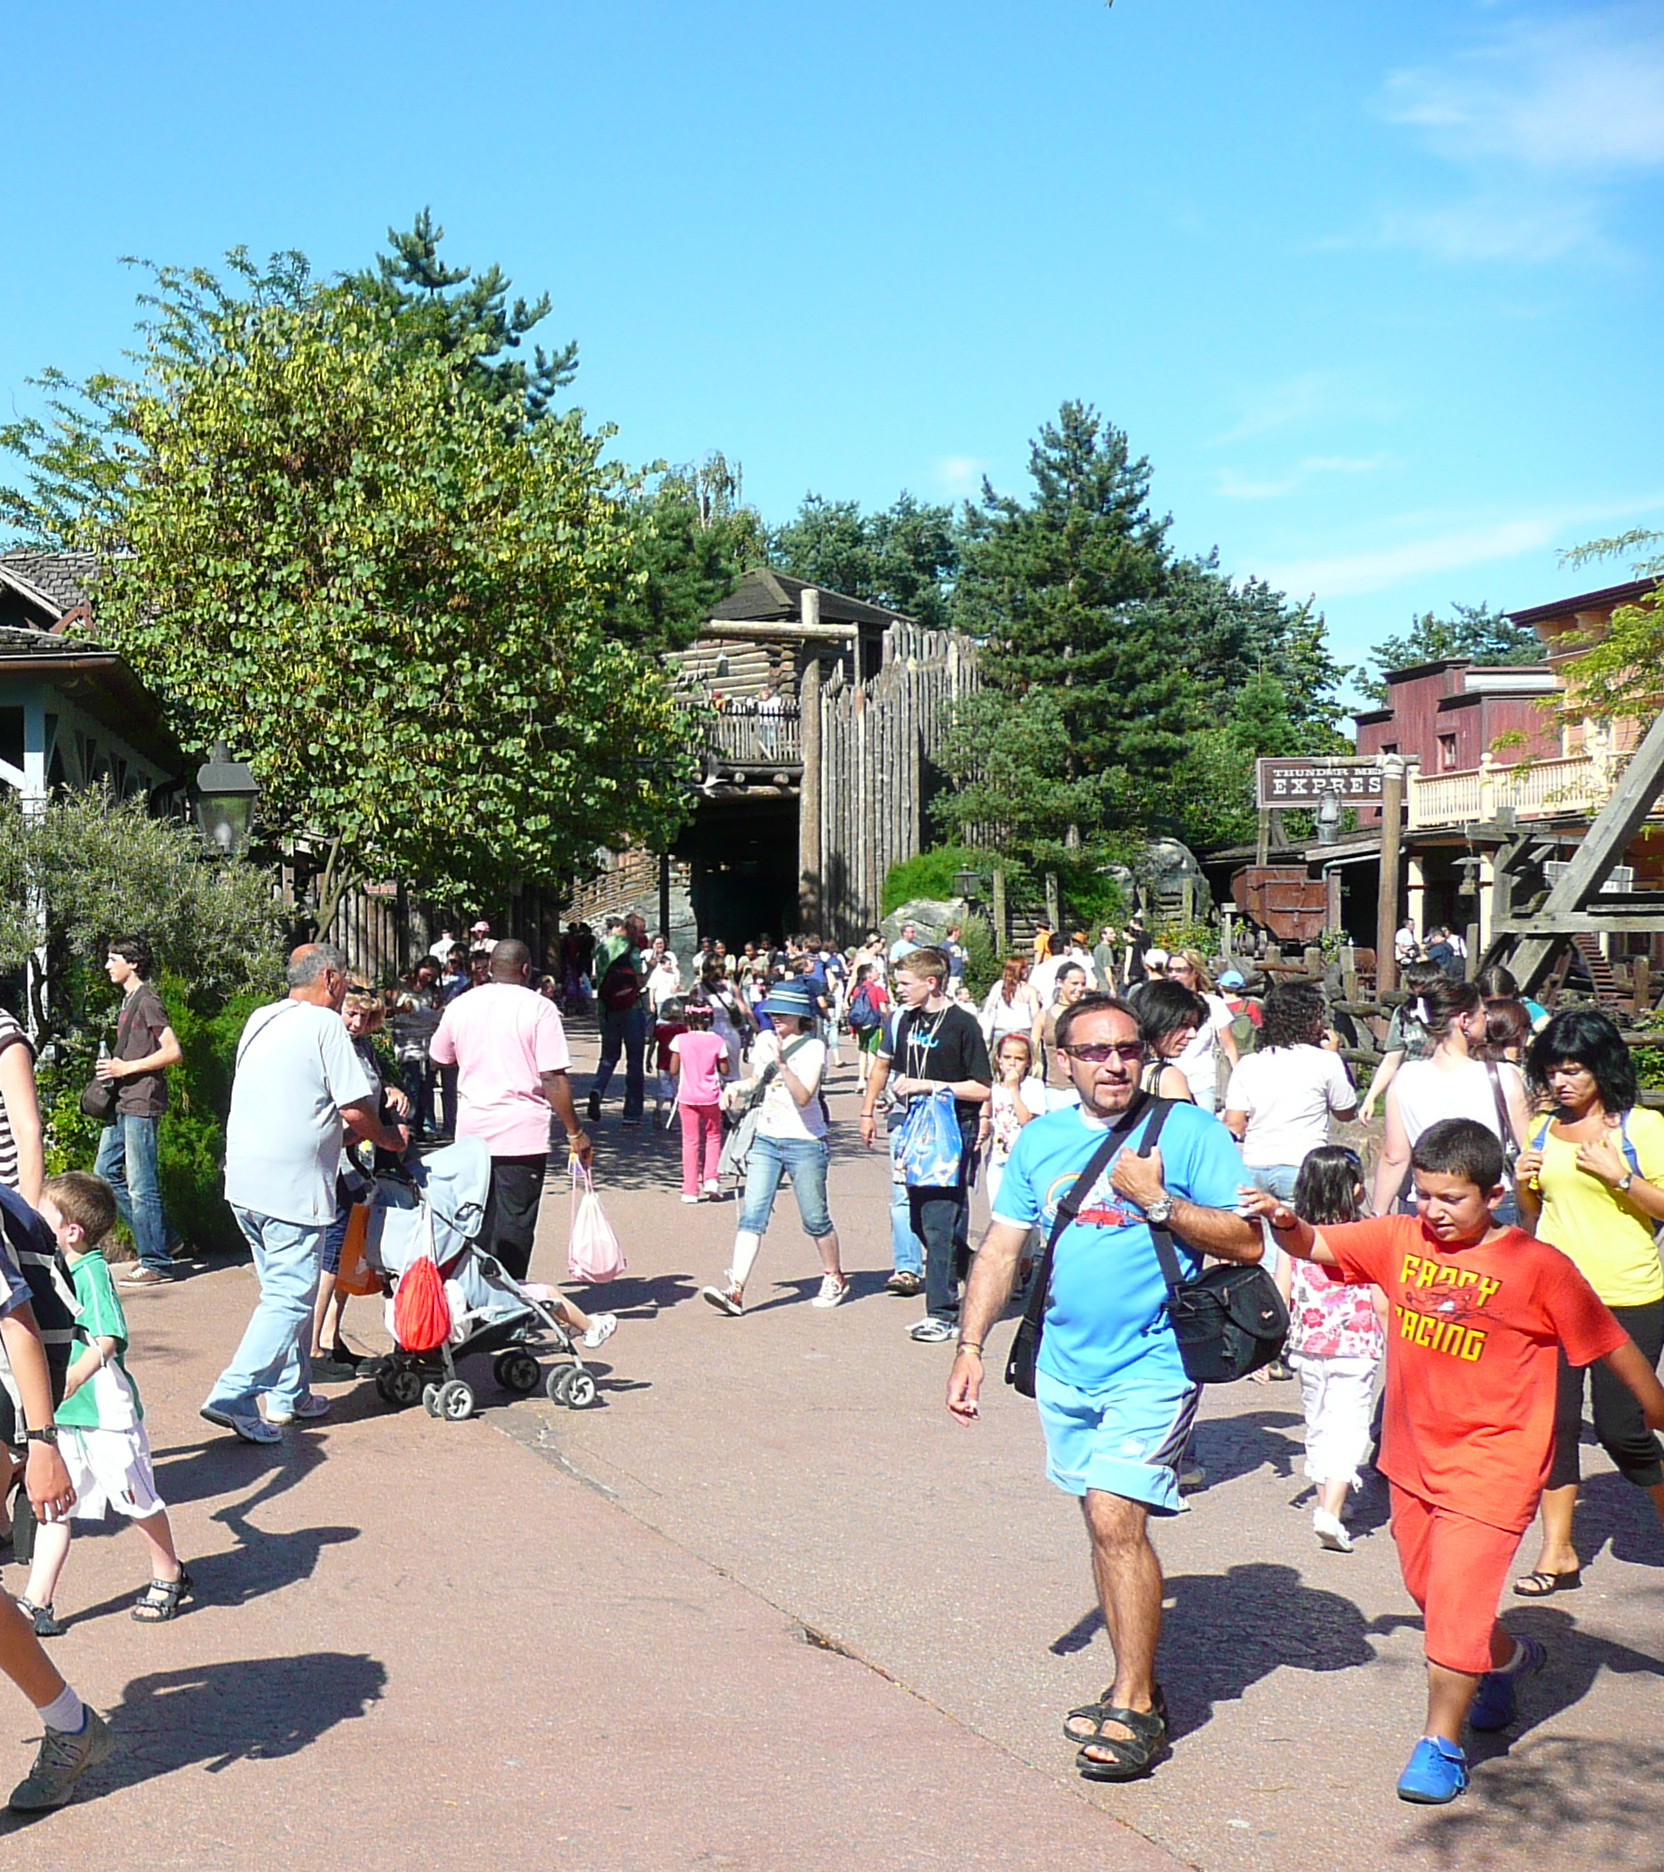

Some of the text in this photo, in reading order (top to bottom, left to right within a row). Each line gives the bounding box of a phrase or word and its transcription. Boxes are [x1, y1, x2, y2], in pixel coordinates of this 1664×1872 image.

[1354, 767, 1383, 776] MES
[1273, 778, 1381, 795] EXPRES
[1395, 1304, 1487, 1362] ACING
